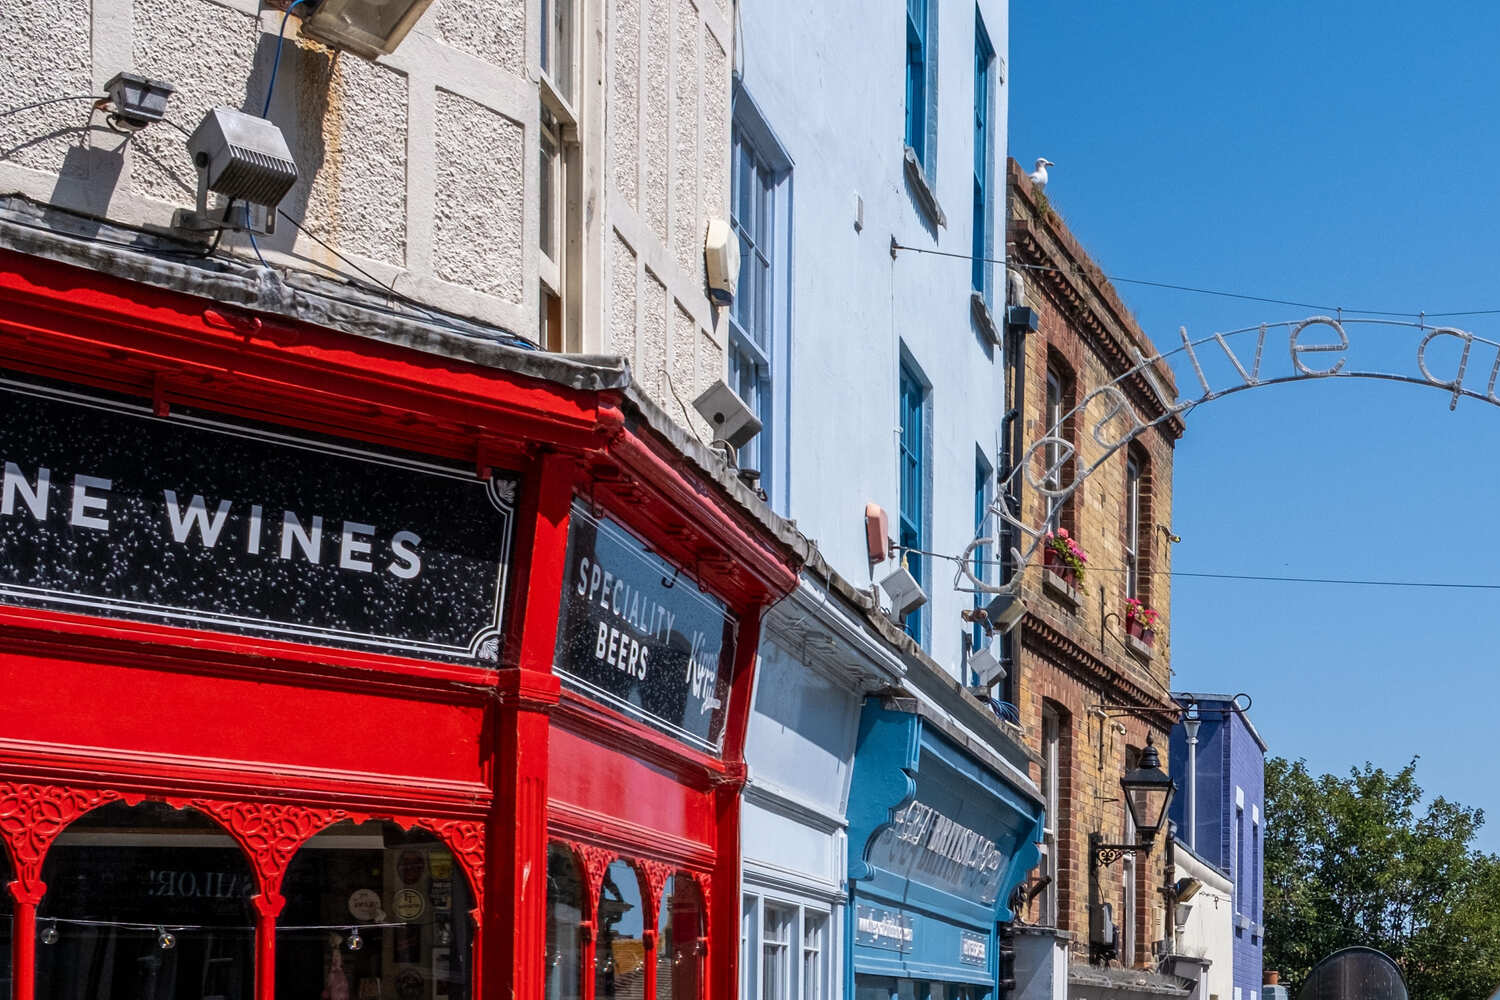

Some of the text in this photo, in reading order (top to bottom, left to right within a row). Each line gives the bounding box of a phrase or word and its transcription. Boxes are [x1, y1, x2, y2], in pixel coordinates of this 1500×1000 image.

[163, 488, 422, 580] WINES
[577, 556, 676, 645] SPECIALITY
[595, 621, 649, 681] BEERS
